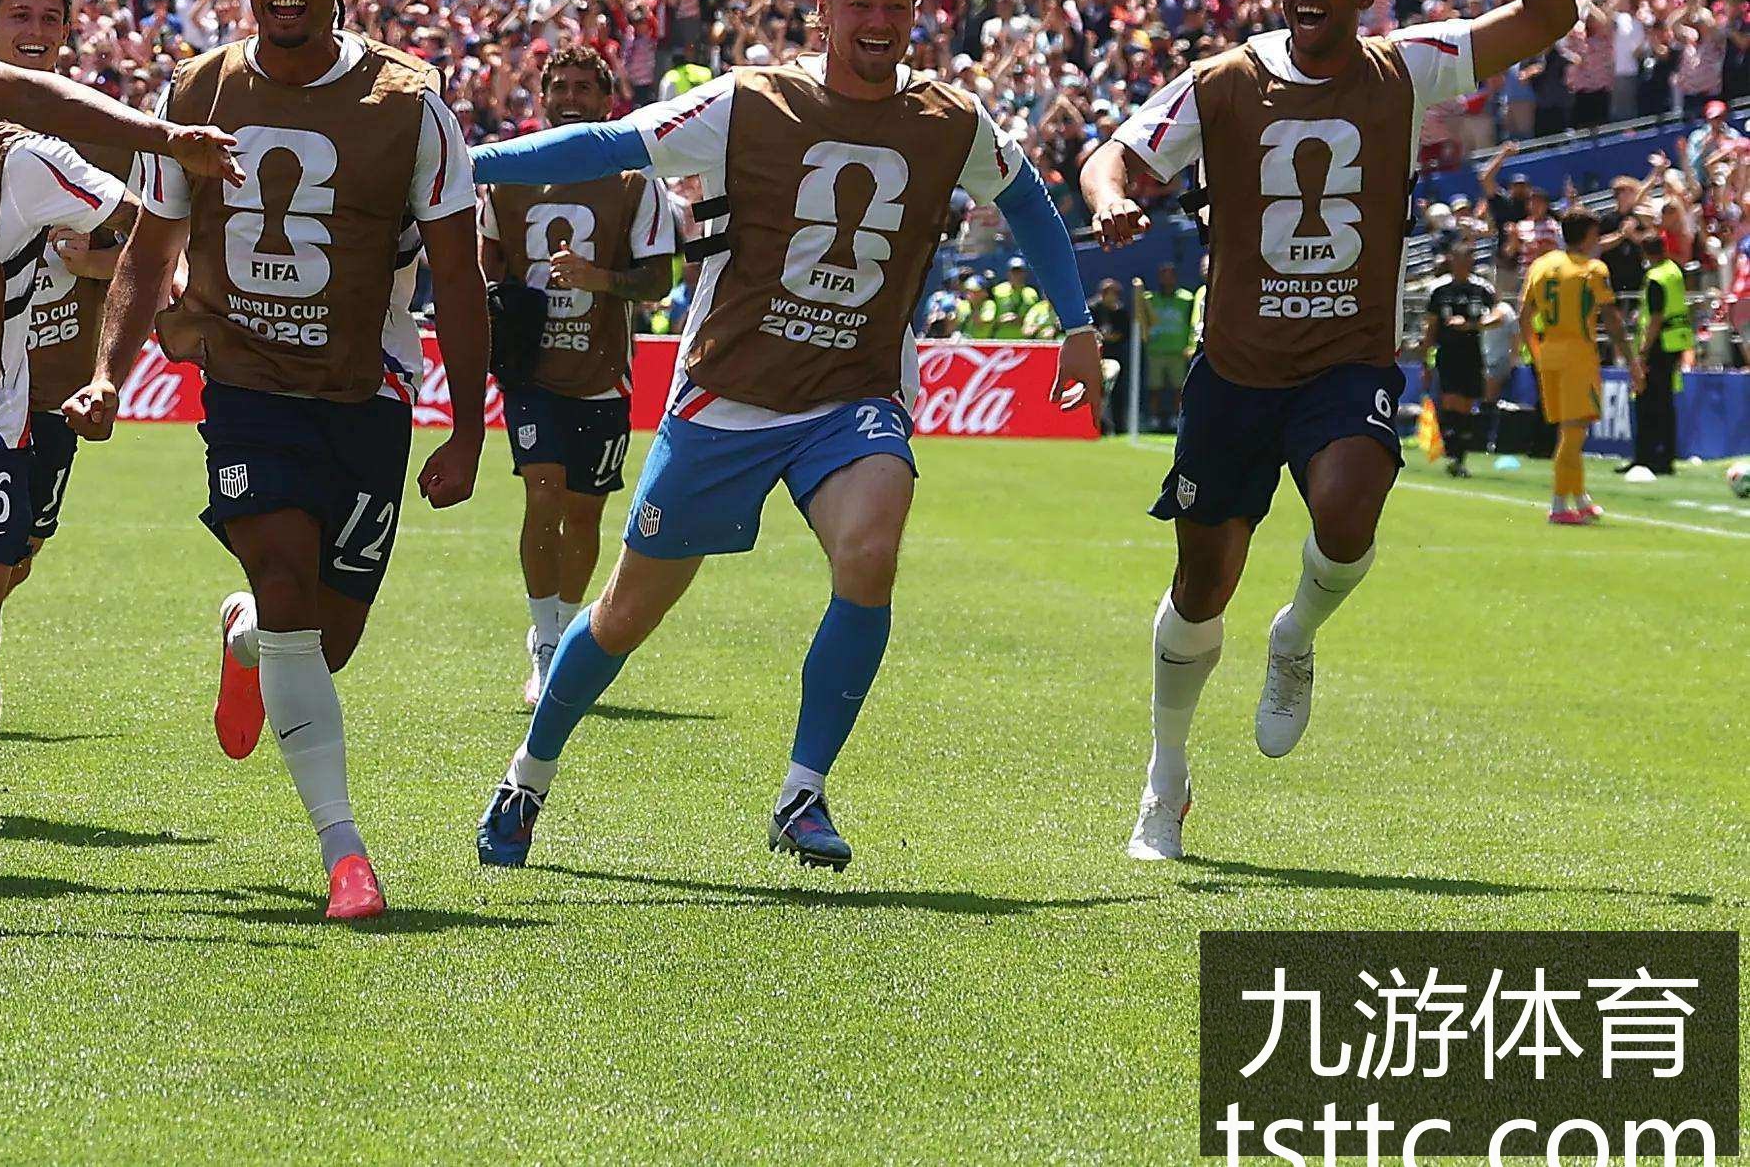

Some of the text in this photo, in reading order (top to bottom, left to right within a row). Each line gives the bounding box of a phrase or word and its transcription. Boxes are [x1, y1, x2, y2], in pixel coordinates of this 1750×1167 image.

[1290, 244, 1336, 261] FIFA
[251, 261, 301, 282] FIFA
[809, 269, 855, 294] FIFA
[34, 275, 54, 291] FA
[1260, 278, 1359, 294] WORLD CUP
[50, 302, 79, 319] CUP
[228, 295, 329, 320] WORLD CUP
[769, 297, 868, 328] WORLD CUP
[1259, 294, 1359, 319] 2026
[566, 322, 591, 333] CUP
[758, 314, 858, 349] 2026
[540, 333, 589, 352] 026
[1375, 388, 1392, 418] 6
[597, 434, 626, 475] 10
[221, 465, 246, 480] USA
[642, 503, 660, 519] USA
[335, 492, 394, 561] 12
